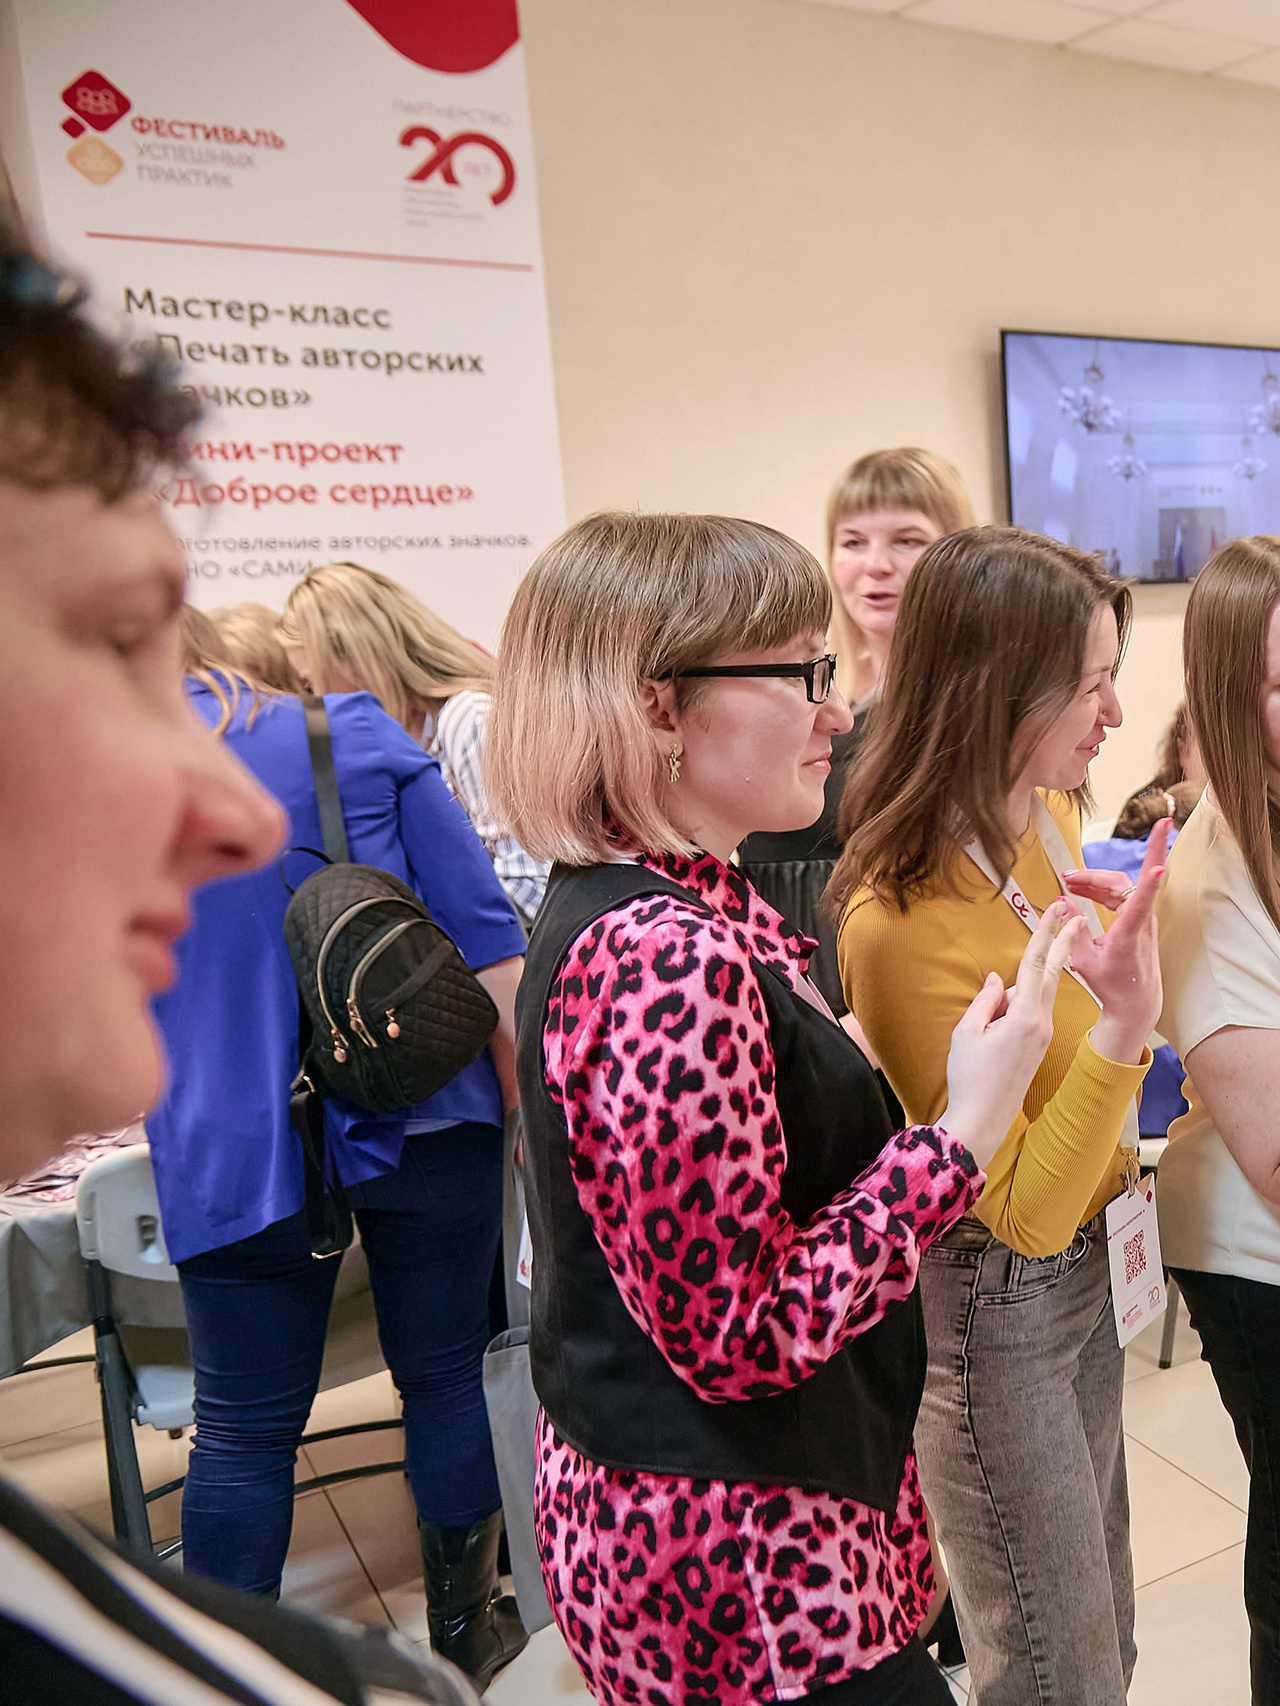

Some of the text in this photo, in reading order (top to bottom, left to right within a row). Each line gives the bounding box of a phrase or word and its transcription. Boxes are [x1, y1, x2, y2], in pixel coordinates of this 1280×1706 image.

[131, 116, 286, 150] ФЕСТИВАЛЬ
[136, 164, 234, 188] ПРАКТИК
[399, 125, 517, 207] 20
[124, 287, 391, 329] Мастер-класс
[301, 346, 484, 376] авторских
[153, 474, 474, 511] «Доброе сердце»
[180, 536, 322, 553] готовление
[328, 535, 442, 553] авторских
[186, 560, 220, 578] НО
